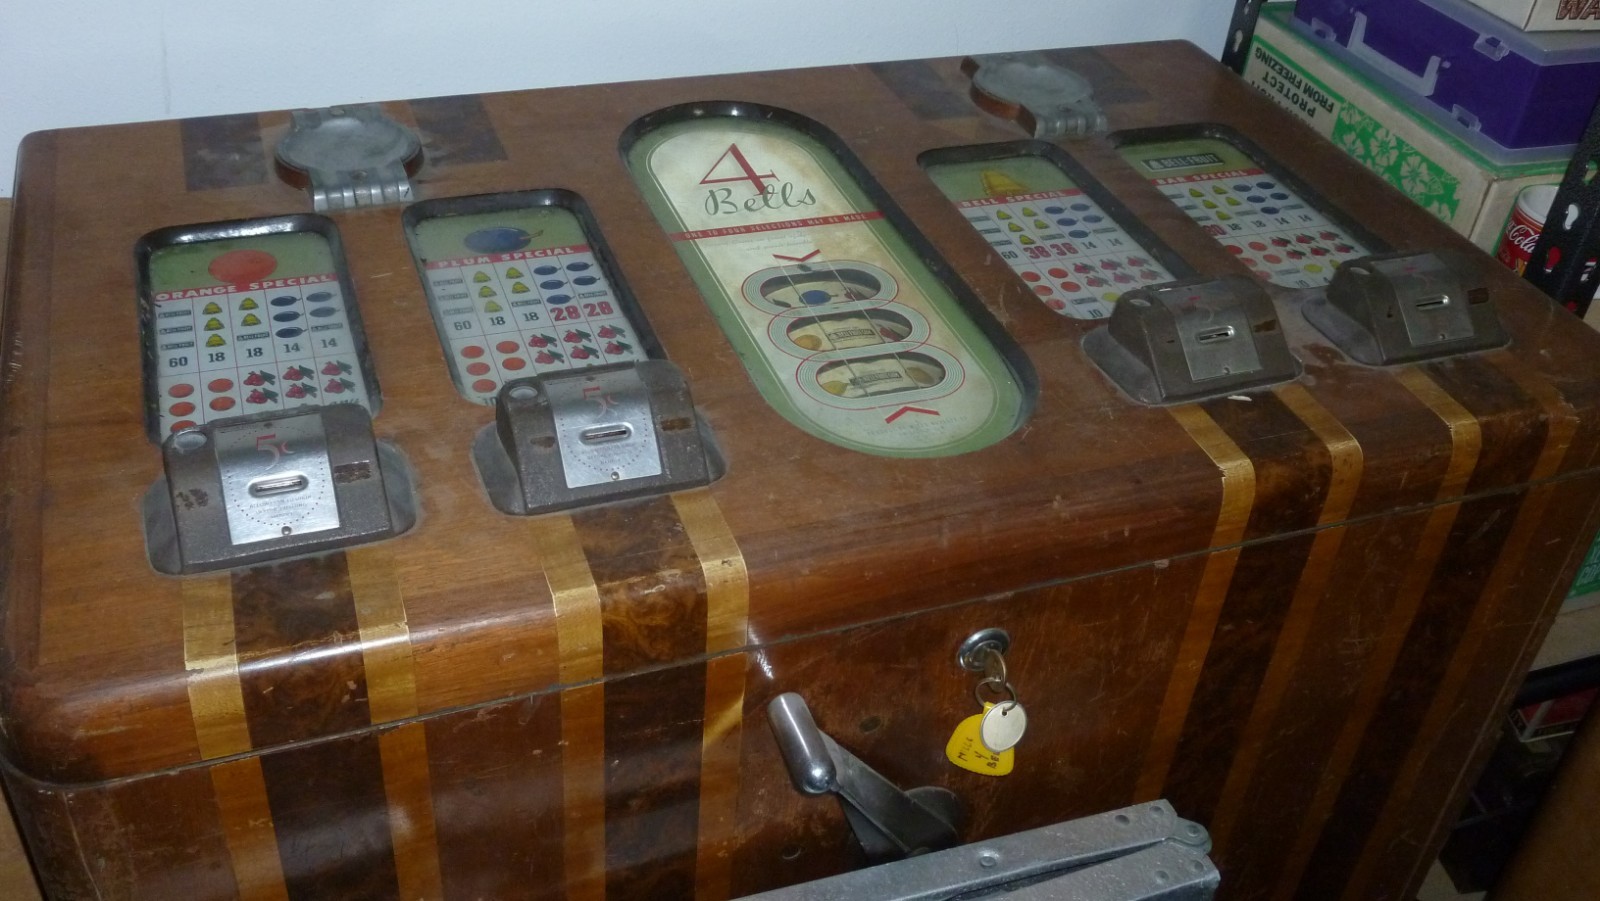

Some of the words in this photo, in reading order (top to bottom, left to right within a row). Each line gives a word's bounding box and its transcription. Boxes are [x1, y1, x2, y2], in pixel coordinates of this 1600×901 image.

[1254, 46, 1303, 89] FREEZING
[1262, 71, 1316, 118] PROTECT
[1301, 83, 1334, 114] FROM
[699, 143, 780, 196] 4
[1156, 176, 1186, 185] BAR
[1191, 170, 1248, 181] SPECIAL
[704, 182, 816, 216] Bells
[961, 197, 999, 208] BELL
[1005, 191, 1064, 203] SPECIAL
[685, 230, 703, 239] ONE
[708, 229, 718, 237] TO
[723, 226, 746, 236] FOUR
[750, 219, 803, 233] SELECTIONS
[807, 217, 825, 226] MAY
[843, 213, 868, 222] MADE
[438, 255, 491, 268] PLUM
[501, 247, 575, 262] SPECIAL
[1001, 250, 1018, 260] 60
[155, 285, 237, 300] ORANGE
[249, 274, 331, 291] SPECIAL
[453, 320, 472, 331] 60
[490, 316, 506, 326] 18
[523, 312, 540, 322] 18
[550, 305, 581, 322] 28
[582, 301, 614, 318] 28
[1088, 309, 1103, 318] 10
[168, 356, 188, 368] 60
[207, 352, 225, 363] 18
[246, 347, 263, 358] 18
[283, 343, 301, 353] 14
[320, 338, 337, 348] 14
